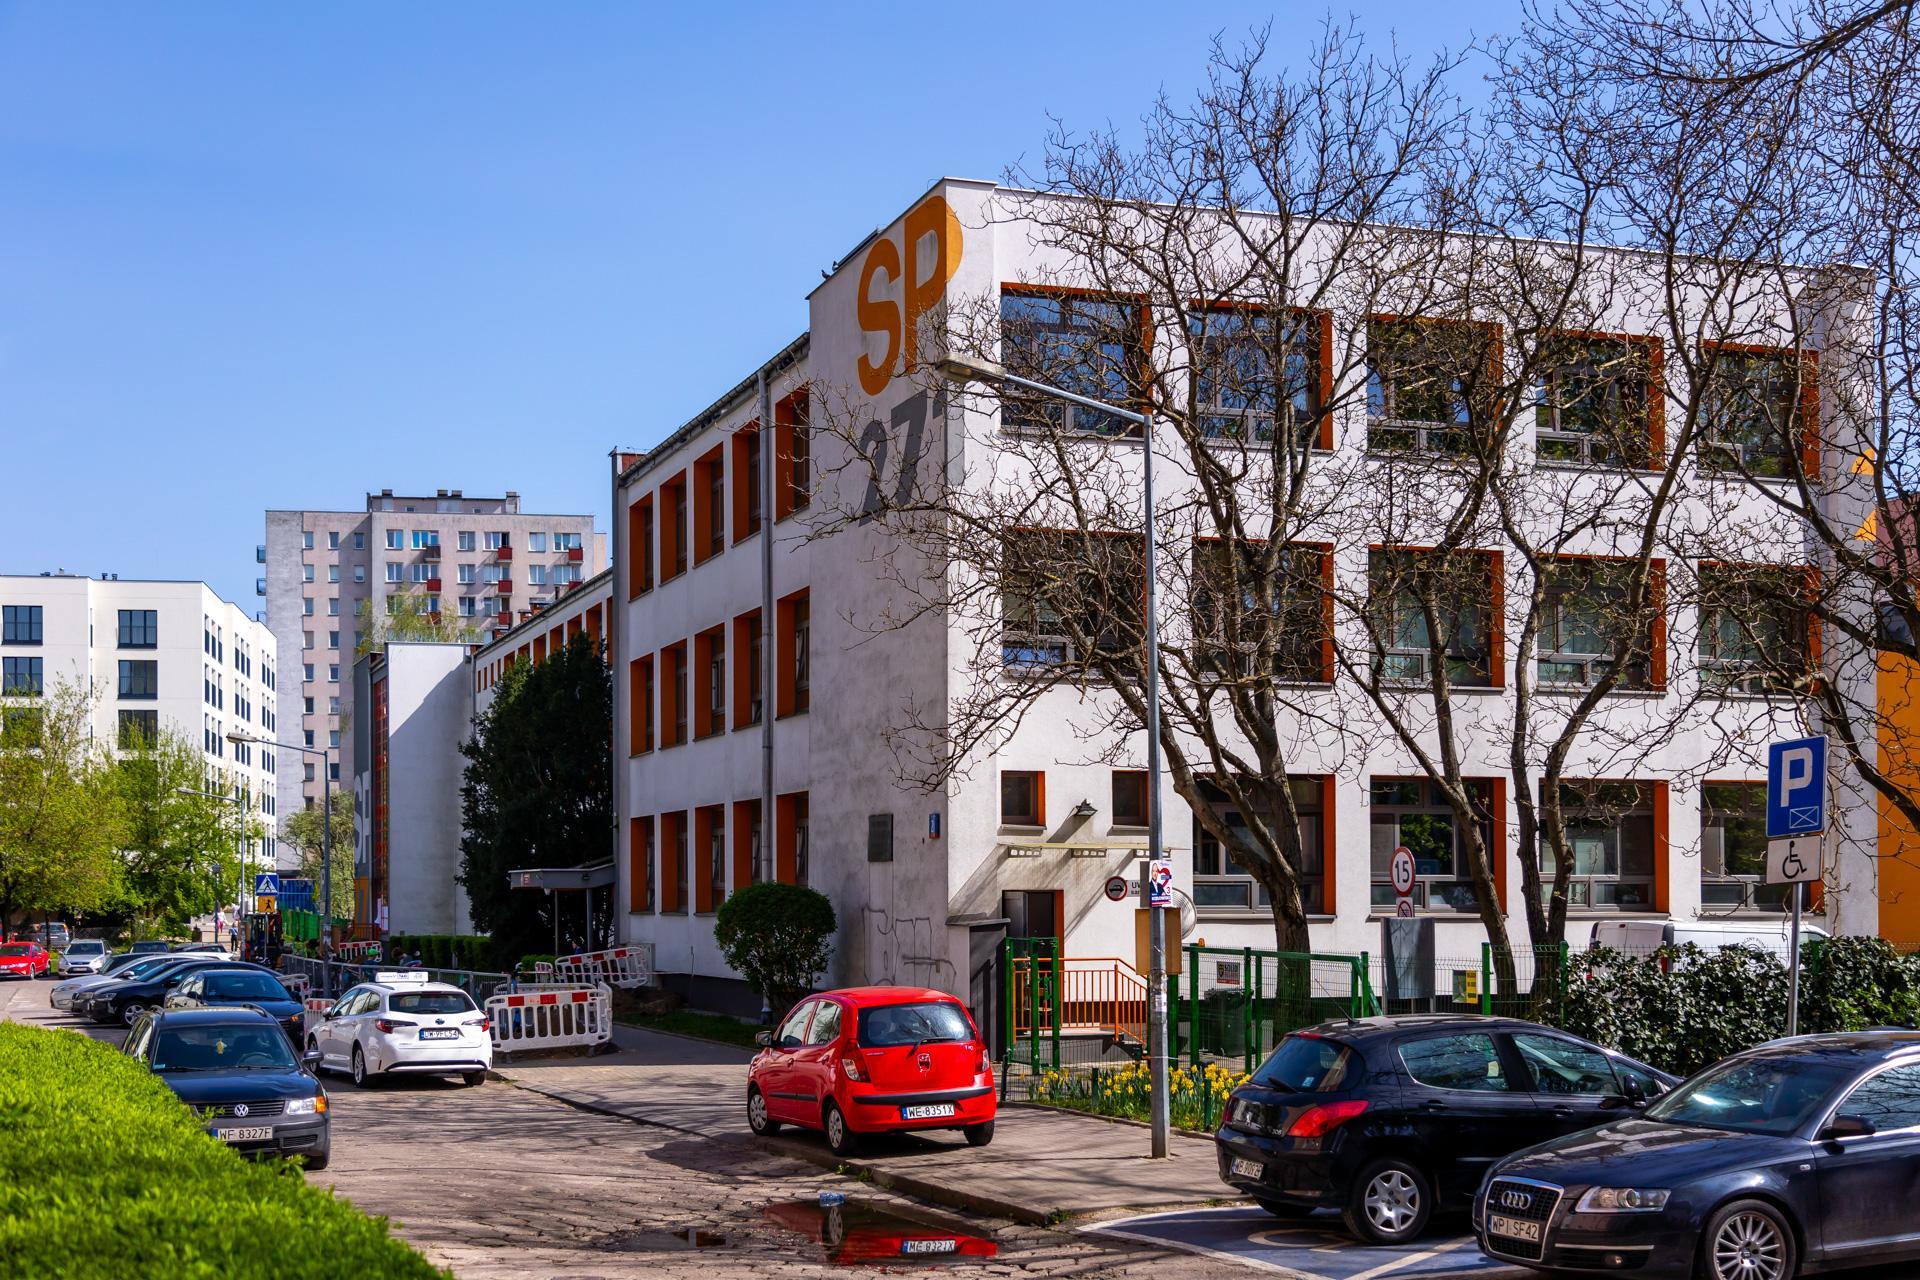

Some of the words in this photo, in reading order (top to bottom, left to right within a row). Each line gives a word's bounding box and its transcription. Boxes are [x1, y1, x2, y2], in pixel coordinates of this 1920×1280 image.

[857, 195, 963, 396] SP
[1780, 747, 1813, 807] P
[1395, 860, 1409, 883] 15
[908, 1107, 922, 1117] WE
[925, 1104, 953, 1116] 8351X
[220, 1130, 234, 1140] WF
[239, 1127, 271, 1139] 8327F
[1513, 1222, 1538, 1239] SF42
